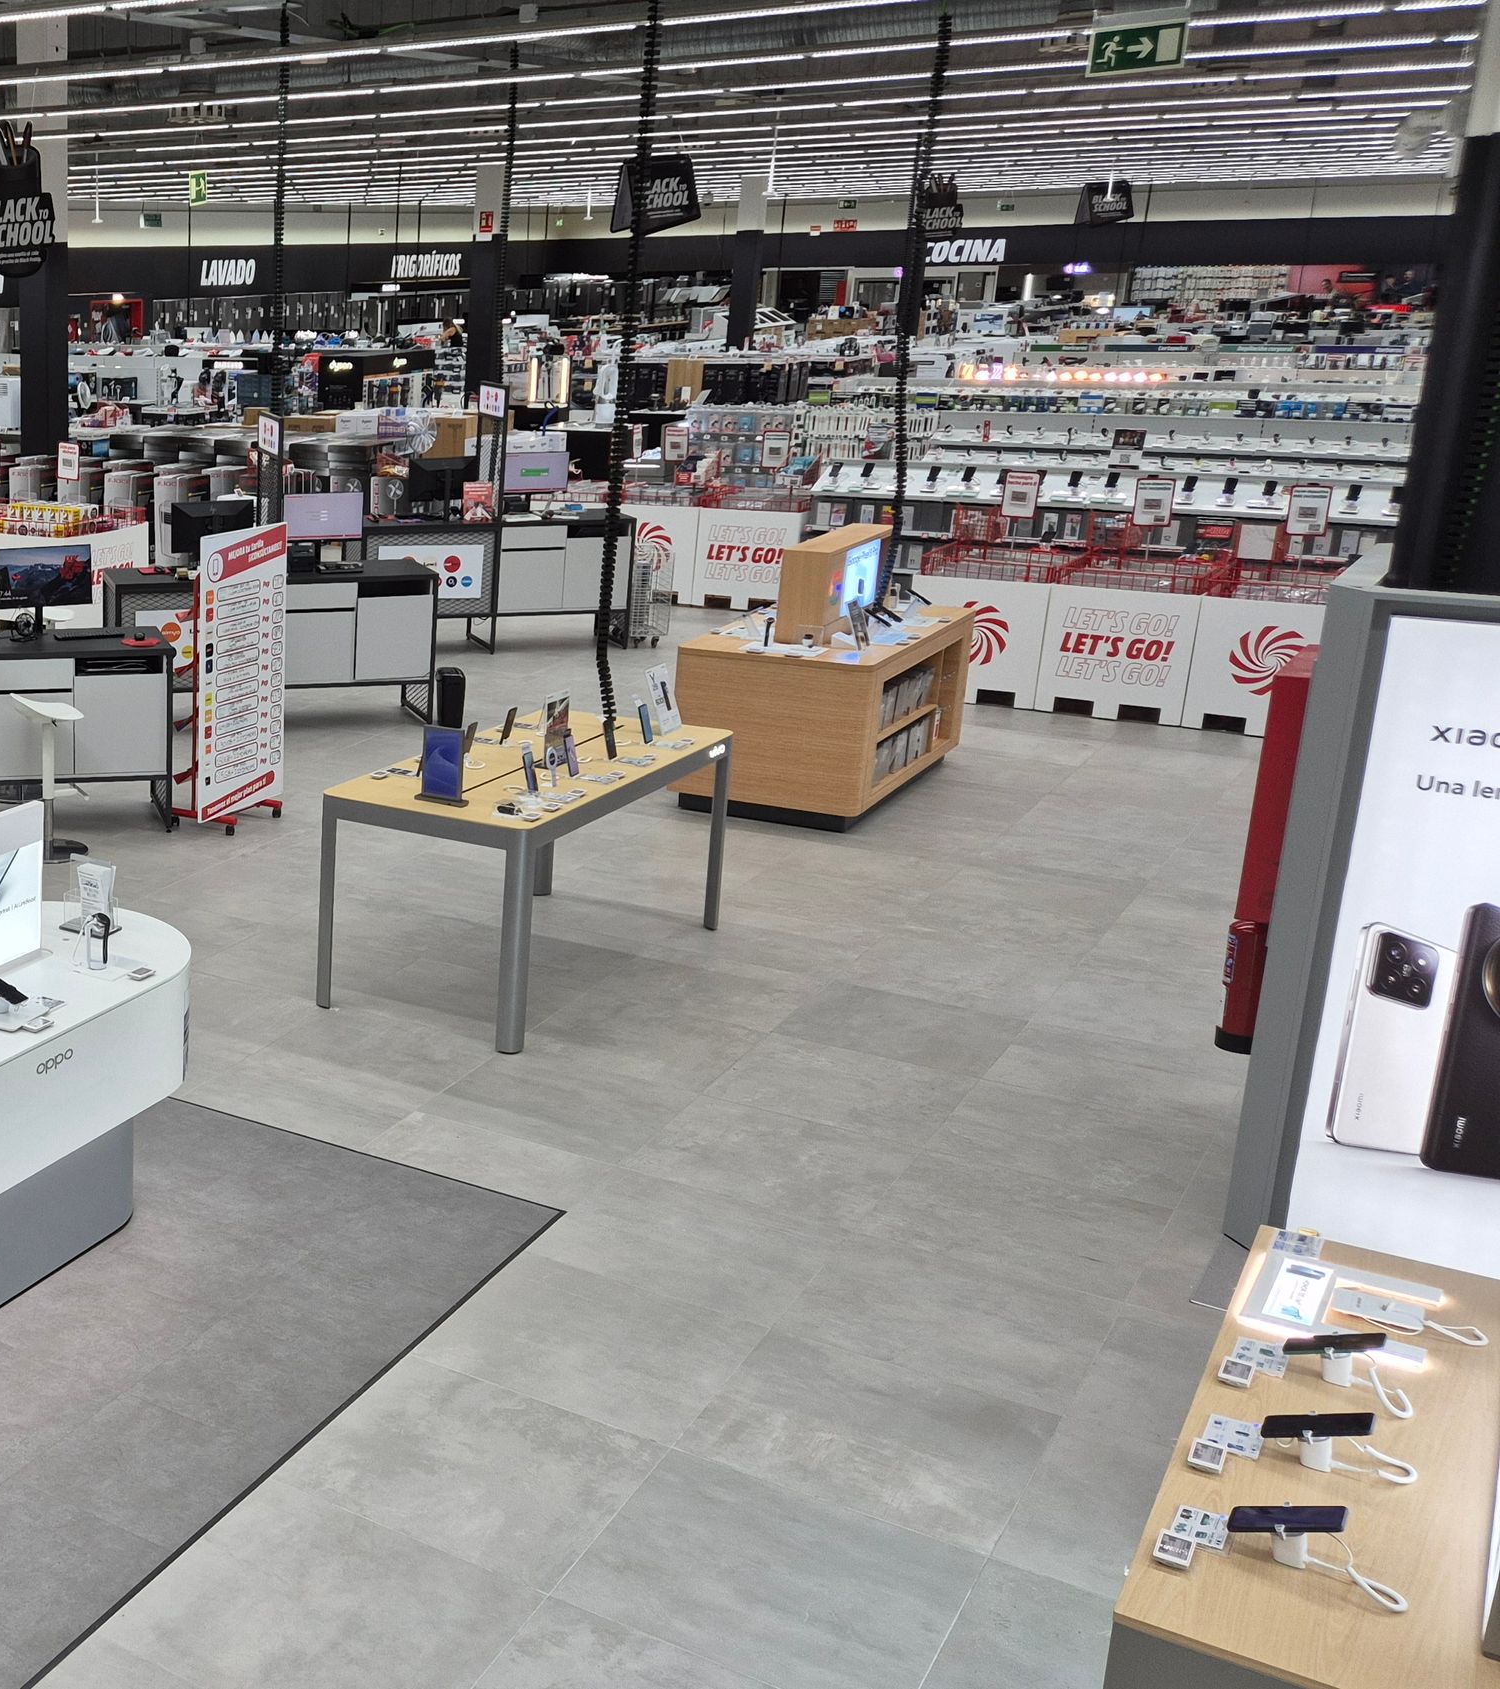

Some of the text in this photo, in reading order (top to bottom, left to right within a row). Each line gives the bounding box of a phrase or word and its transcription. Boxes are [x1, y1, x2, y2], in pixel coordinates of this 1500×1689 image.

[38, 209, 49, 220] TO
[200, 258, 256, 286] LAVADO
[391, 250, 462, 279] FRIGORÍFICOS
[708, 525, 787, 545] LET'S GO!
[707, 544, 784, 565] LET'S GO!
[704, 562, 781, 584] LET'S GO!
[1062, 607, 1180, 638] LET'S GO!
[1060, 631, 1175, 662] LET'S GO!
[1055, 656, 1172, 688] LET'S GO!
[1416, 774, 1465, 797] Una
[36, 1047, 73, 1076] oppo
